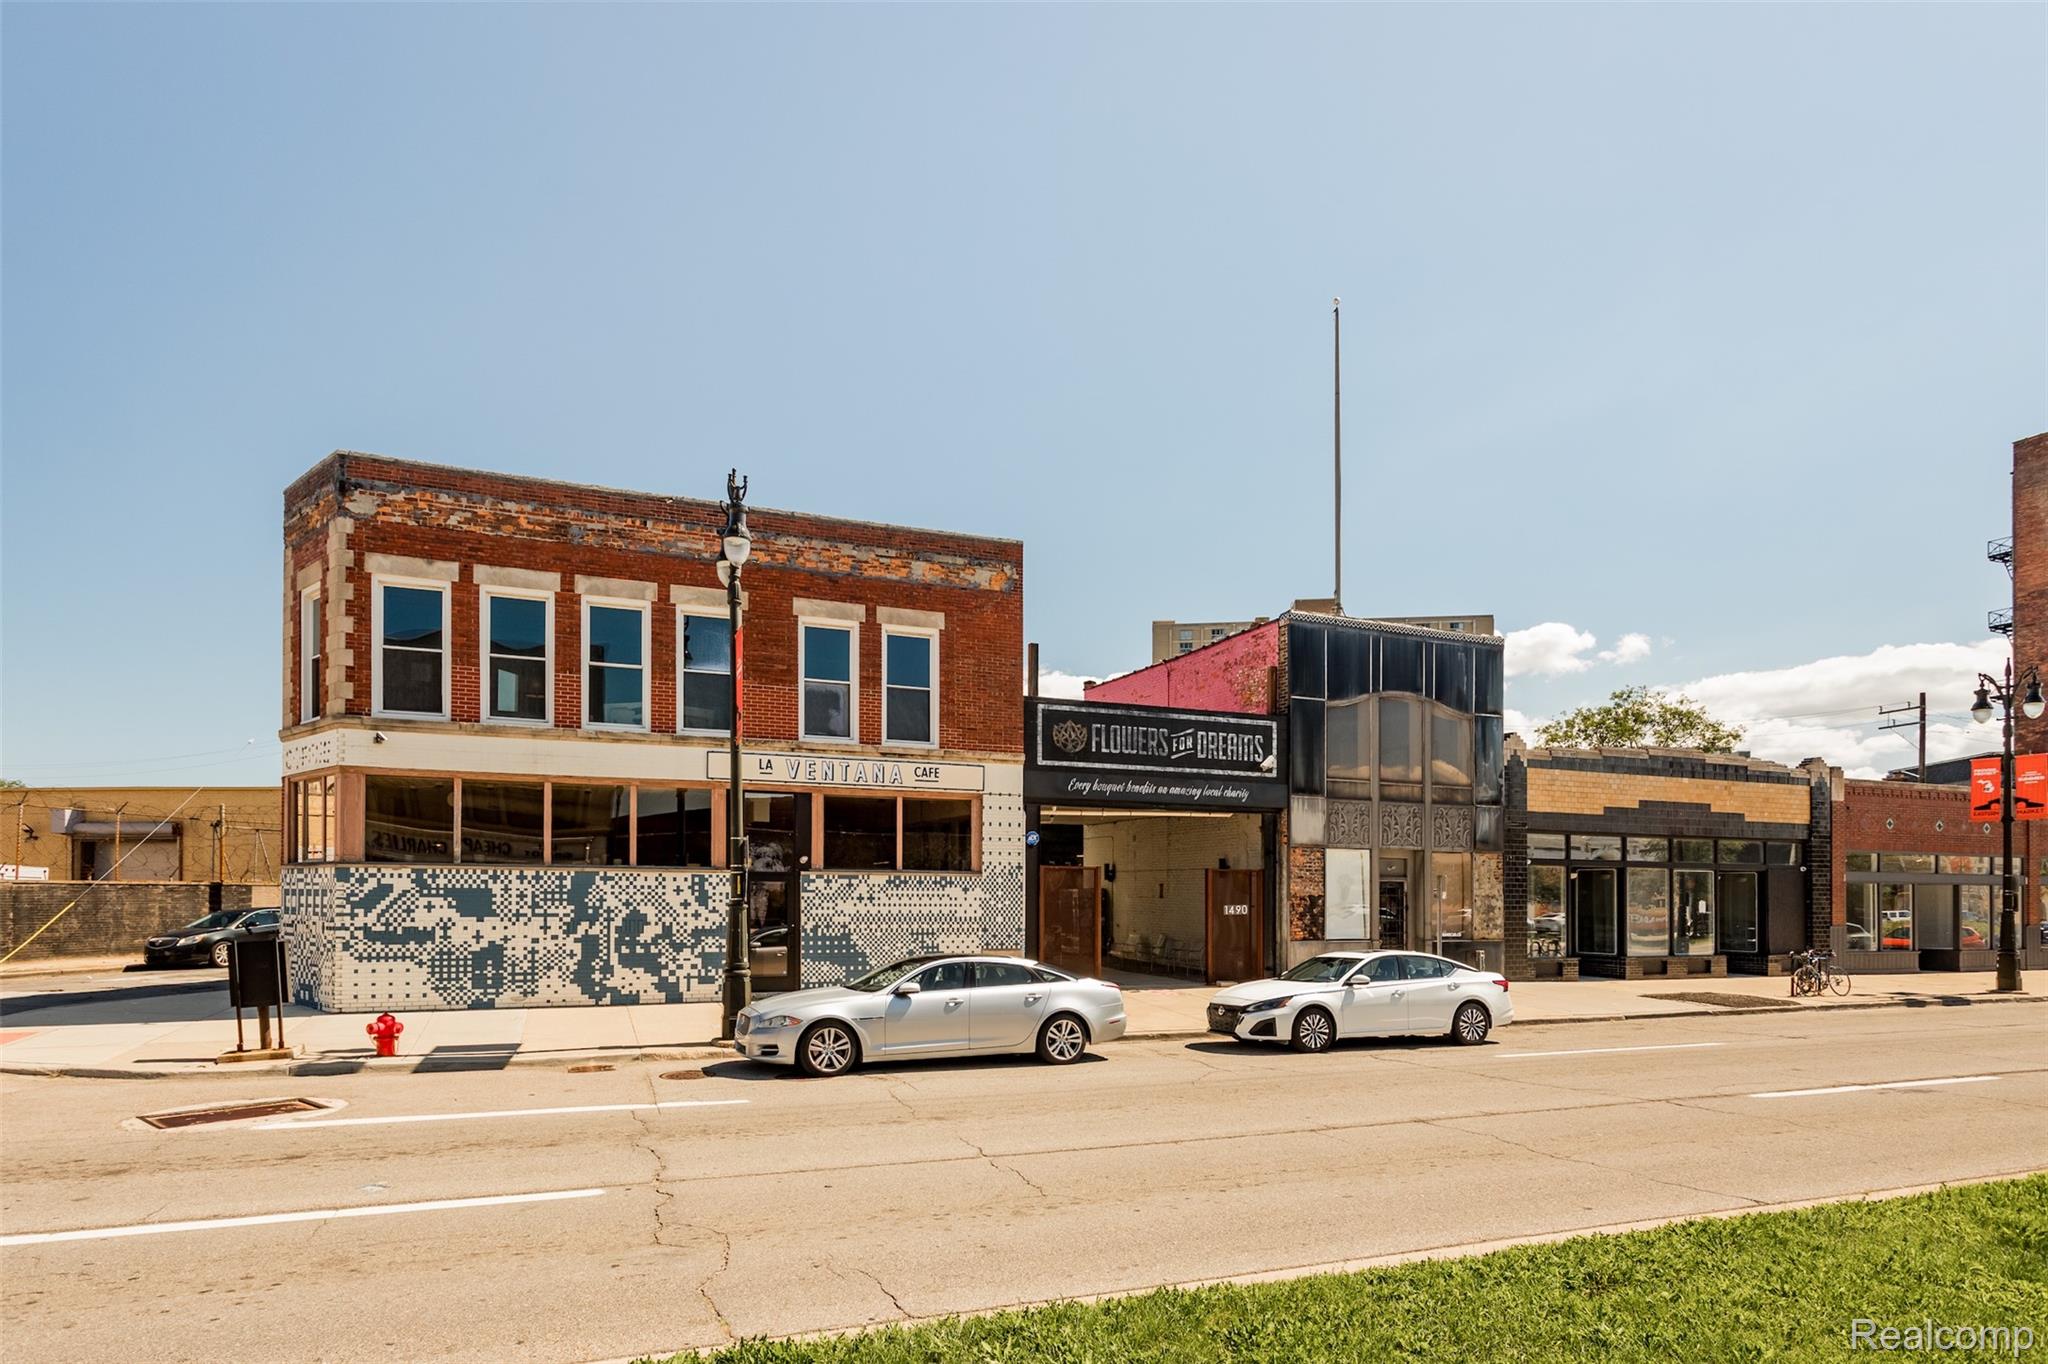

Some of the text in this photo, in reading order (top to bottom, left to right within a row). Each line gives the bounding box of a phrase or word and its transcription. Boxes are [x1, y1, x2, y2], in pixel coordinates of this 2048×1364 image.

[1091, 723, 1264, 762] FLOWERS FOR DREAMS
[759, 758, 940, 784] LA VENTANA CAFE
[1068, 778, 1249, 802] Every bouquet benefits an amazing local charity
[1224, 904, 1248, 915] 1490
